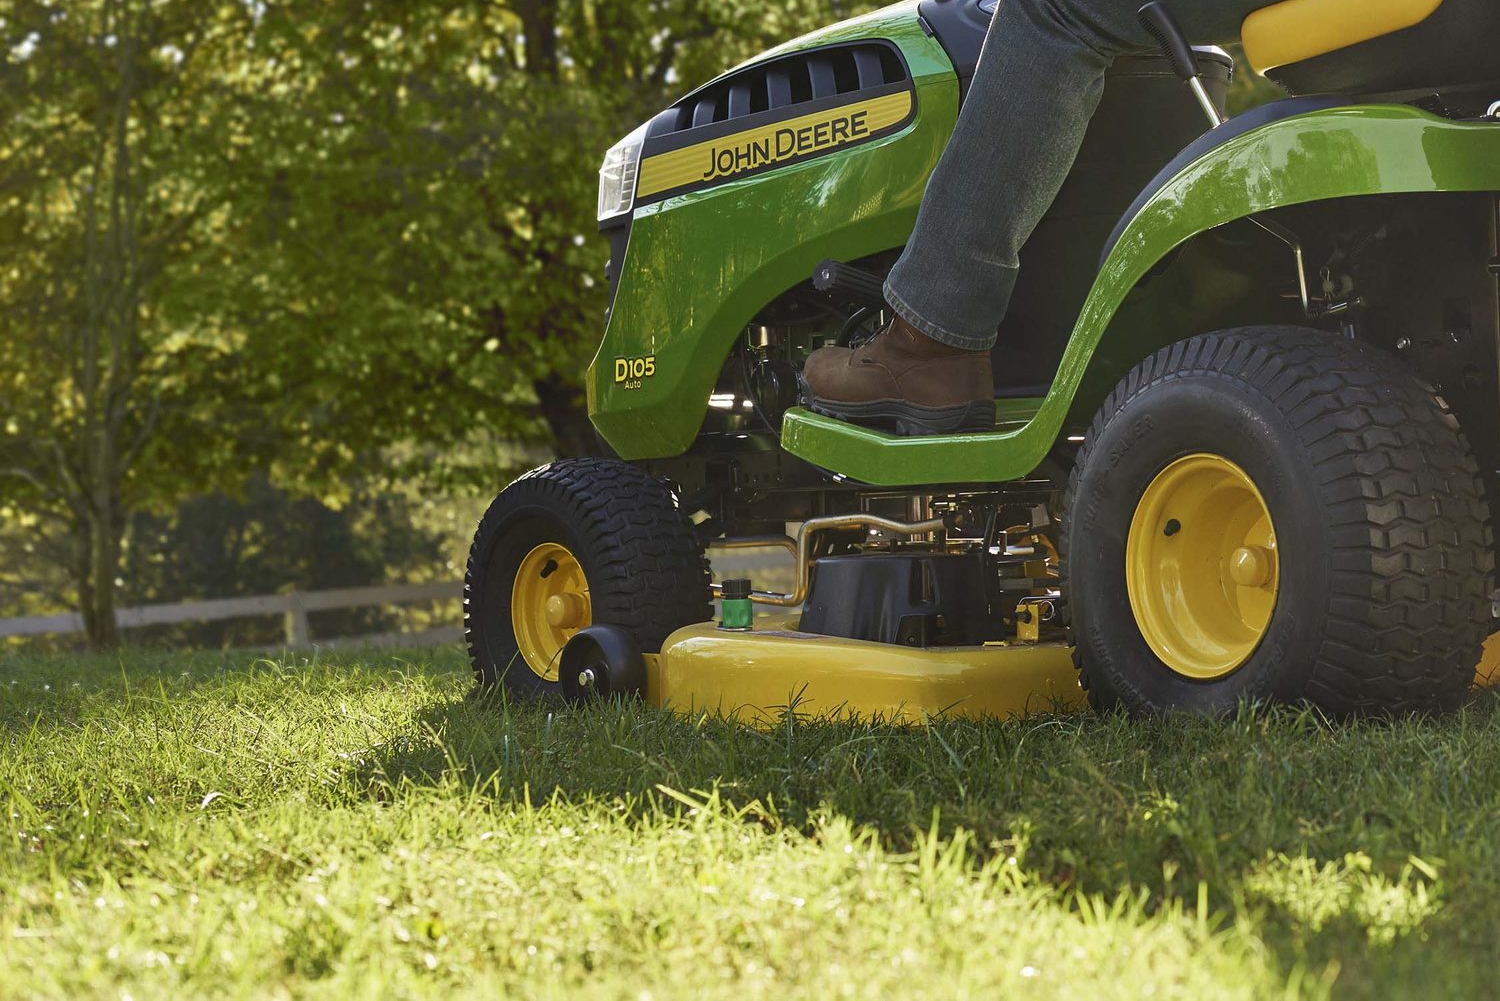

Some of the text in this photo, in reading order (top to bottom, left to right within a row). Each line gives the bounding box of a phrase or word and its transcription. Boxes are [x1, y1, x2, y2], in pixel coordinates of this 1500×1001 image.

[703, 110, 869, 178] JOHN DEERE
[615, 356, 655, 382] D105
[624, 380, 642, 390] Auto
